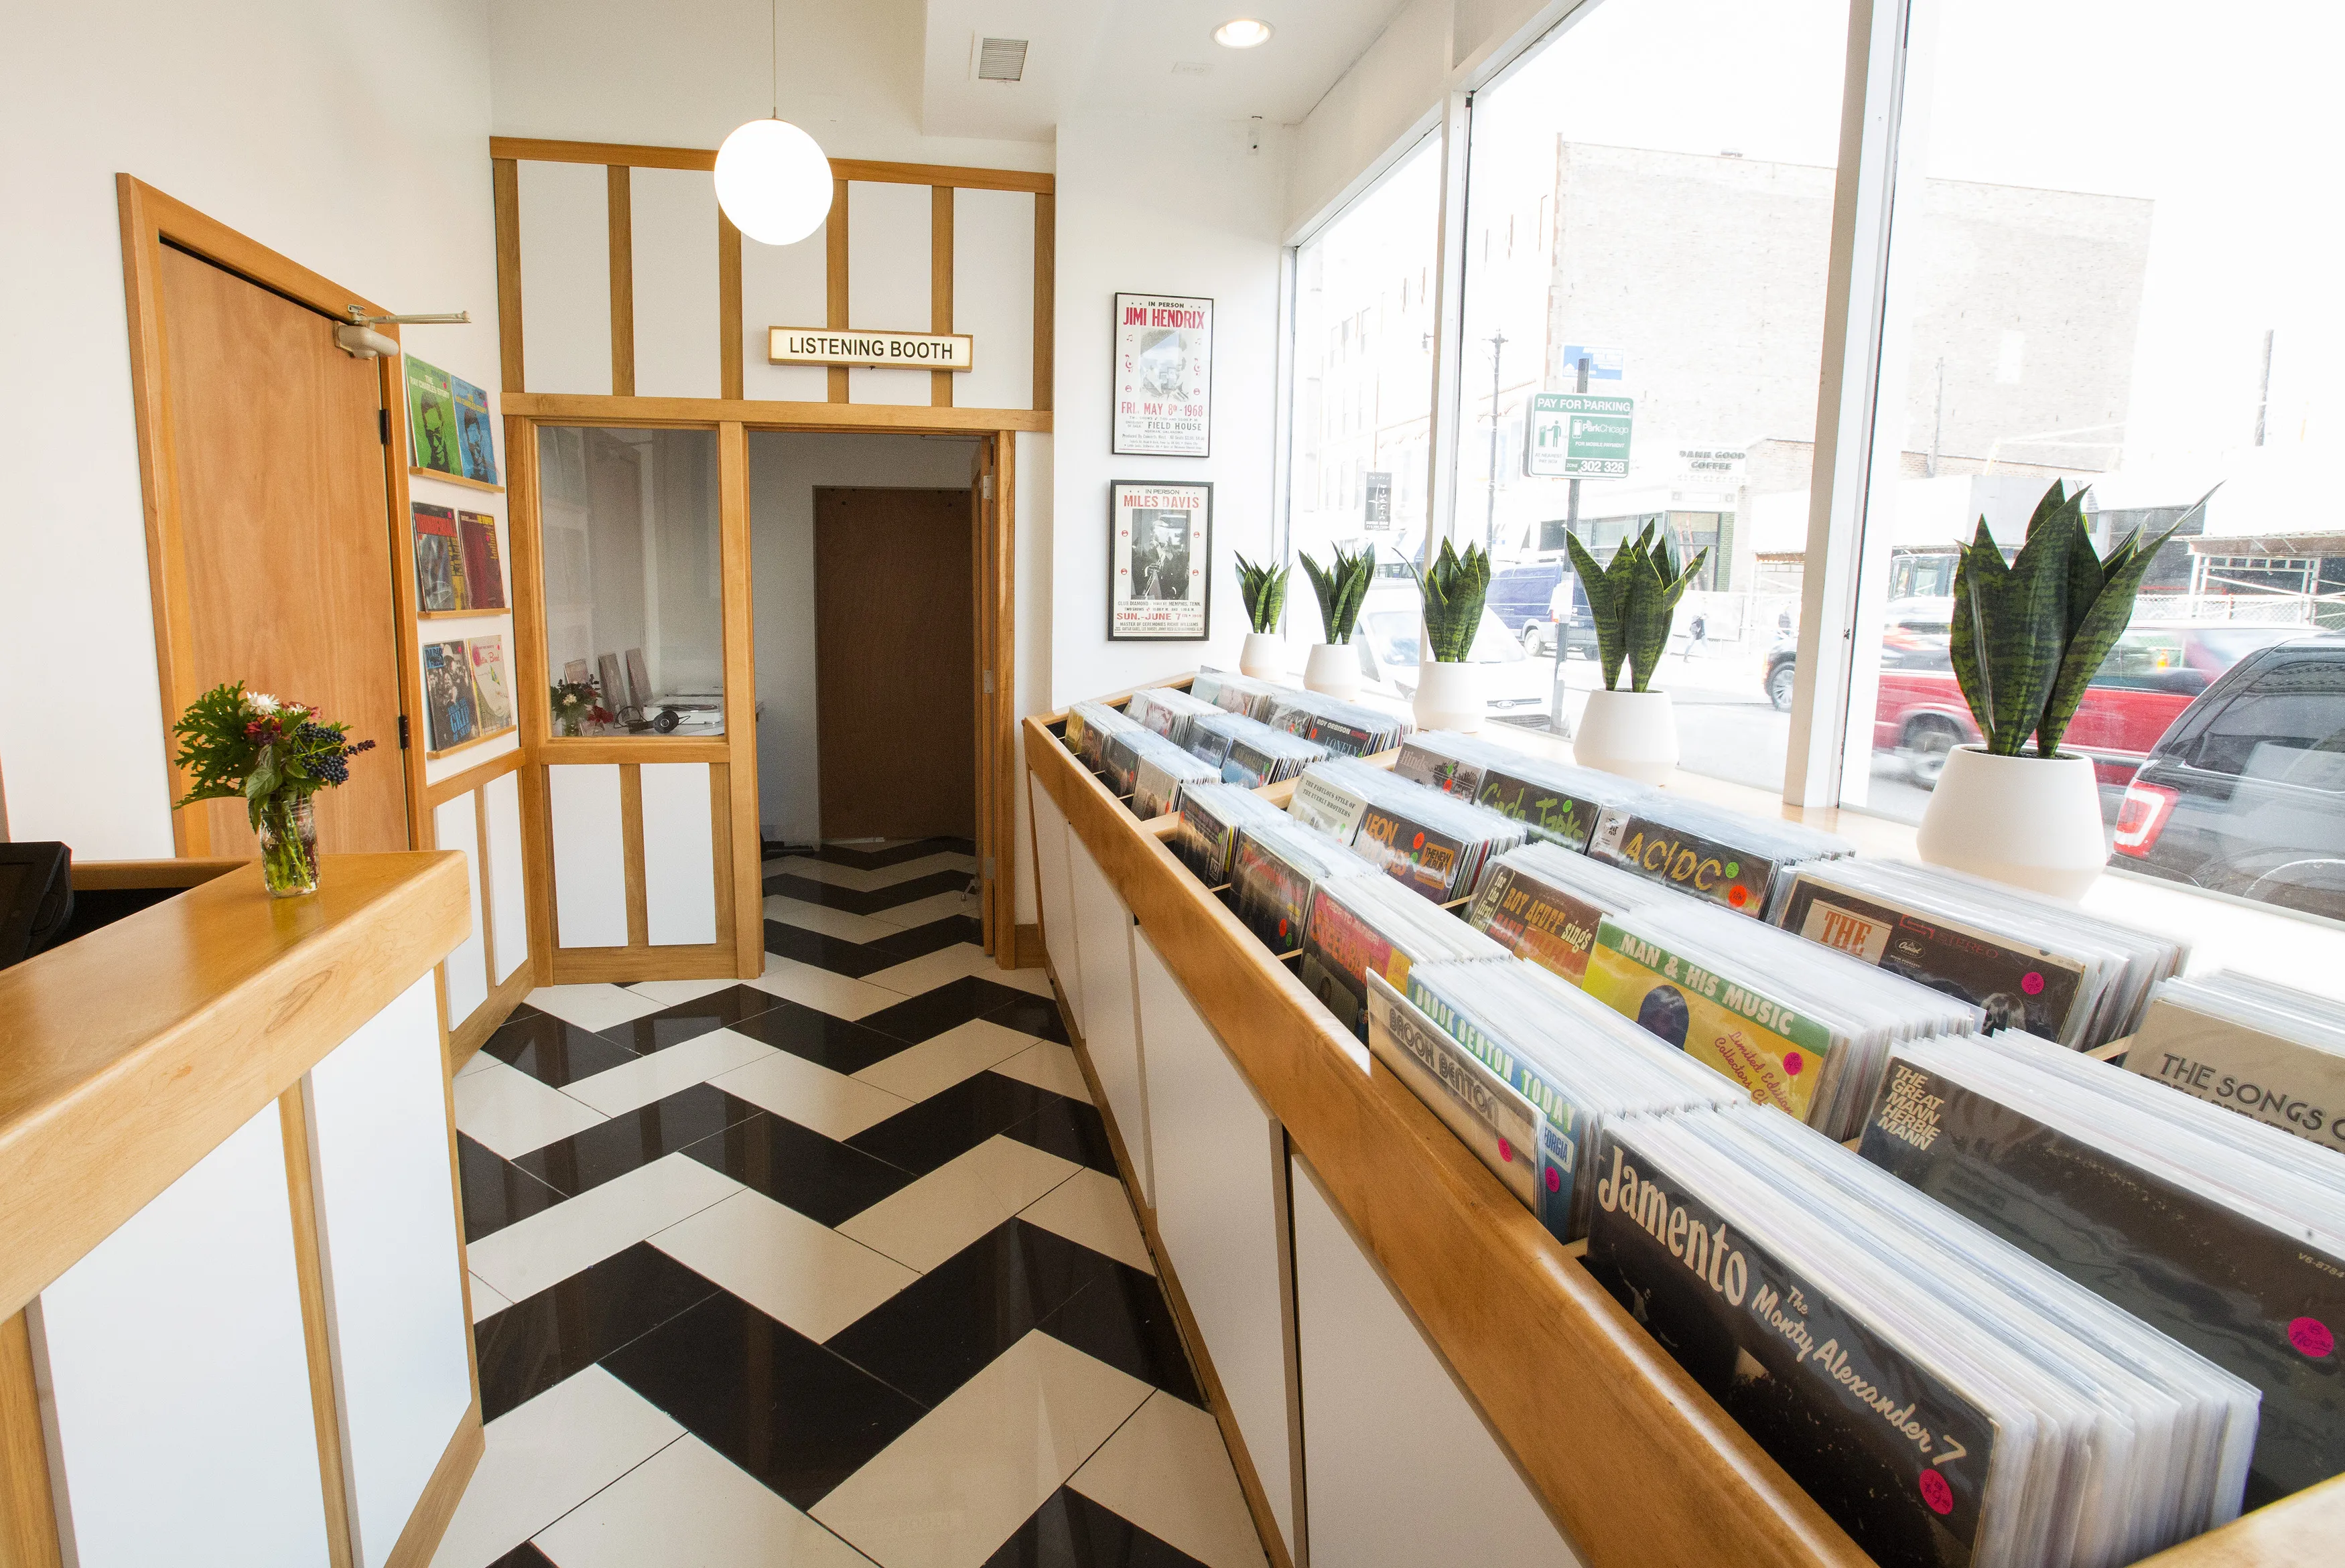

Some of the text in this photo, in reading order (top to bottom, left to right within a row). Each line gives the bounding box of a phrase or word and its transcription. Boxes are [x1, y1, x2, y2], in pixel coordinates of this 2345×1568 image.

[1123, 307, 1205, 329] JIMI HENDRIX
[789, 337, 953, 359] LISTENING BOOTH
[1144, 403, 1163, 415] MAY
[1185, 405, 1203, 417] 1968
[1538, 398, 1631, 412] PAY FOR PARKING
[1148, 421, 1202, 431] FIELD HOUSE
[1583, 423, 1629, 435] ParkChicago
[1581, 461, 1601, 472] 302
[1604, 461, 1625, 473] 328
[1691, 461, 1732, 470] COFFEE
[1715, 451, 1746, 459] GOOD
[1124, 495, 1199, 508] MILES DAVIS
[1317, 719, 1327, 728] ROY
[1327, 722, 1351, 735] ORBISON
[1325, 737, 1360, 757] LONELY
[1302, 788, 1351, 818] THE EVERLY BROTHERS
[1305, 780, 1356, 810] THE FABULOUS STYLE OF
[1364, 812, 1400, 846] LEON
[1623, 833, 1722, 892] AC/DC
[1487, 886, 1499, 904] the
[1494, 872, 1507, 888] for
[1478, 900, 1495, 919] first
[1503, 887, 1593, 954] ROY ACUFF sings
[1820, 910, 1873, 956] THE
[1898, 941, 1922, 954] Capitol
[1938, 932, 1999, 958] STEREO
[1620, 934, 1795, 1036] MAN & HIS MUSIC
[1389, 1007, 1435, 1069] BROOK
[1416, 983, 1575, 1134] BROOK BENTON TODAY
[1715, 1037, 1753, 1090] Collectors
[1728, 1031, 1794, 1115] Limited Edition
[1895, 1064, 1929, 1089] THE
[2160, 1052, 2216, 1090] THE
[2216, 1076, 2324, 1131] SONGS
[1885, 1090, 1942, 1126] MANN
[1891, 1078, 1946, 1111] GREAT
[1876, 1115, 1932, 1151] MANN
[1881, 1104, 1942, 1141] HERBIE
[1598, 1145, 1747, 1307] Jamento
[1787, 1285, 1808, 1317] The
[1751, 1283, 1968, 1466] Monty Alexander 7
